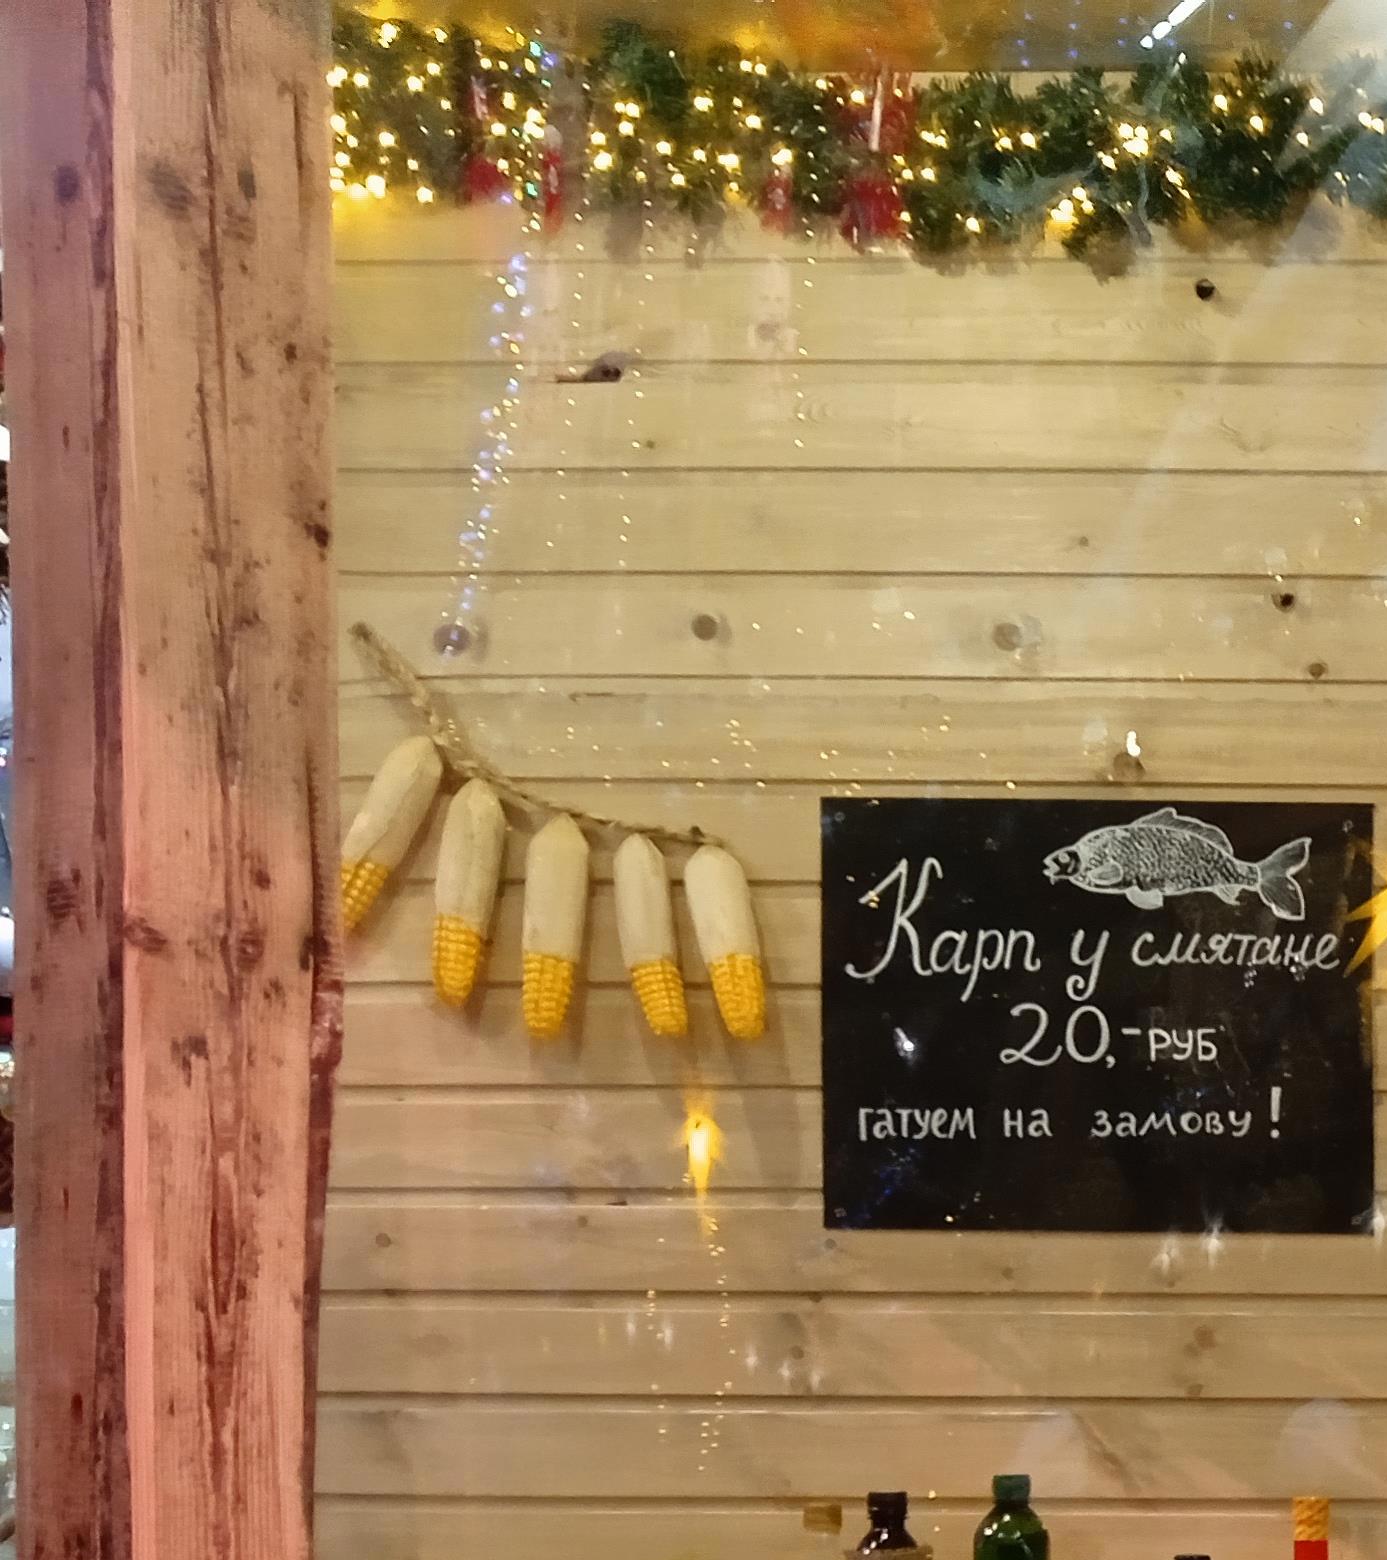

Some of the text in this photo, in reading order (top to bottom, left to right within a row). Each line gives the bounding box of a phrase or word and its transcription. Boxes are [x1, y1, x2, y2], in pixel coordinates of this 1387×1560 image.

[845, 857, 1340, 1002] Карп у смятане
[858, 1106, 977, 1142] гатуем
[1003, 1107, 1053, 1138] на
